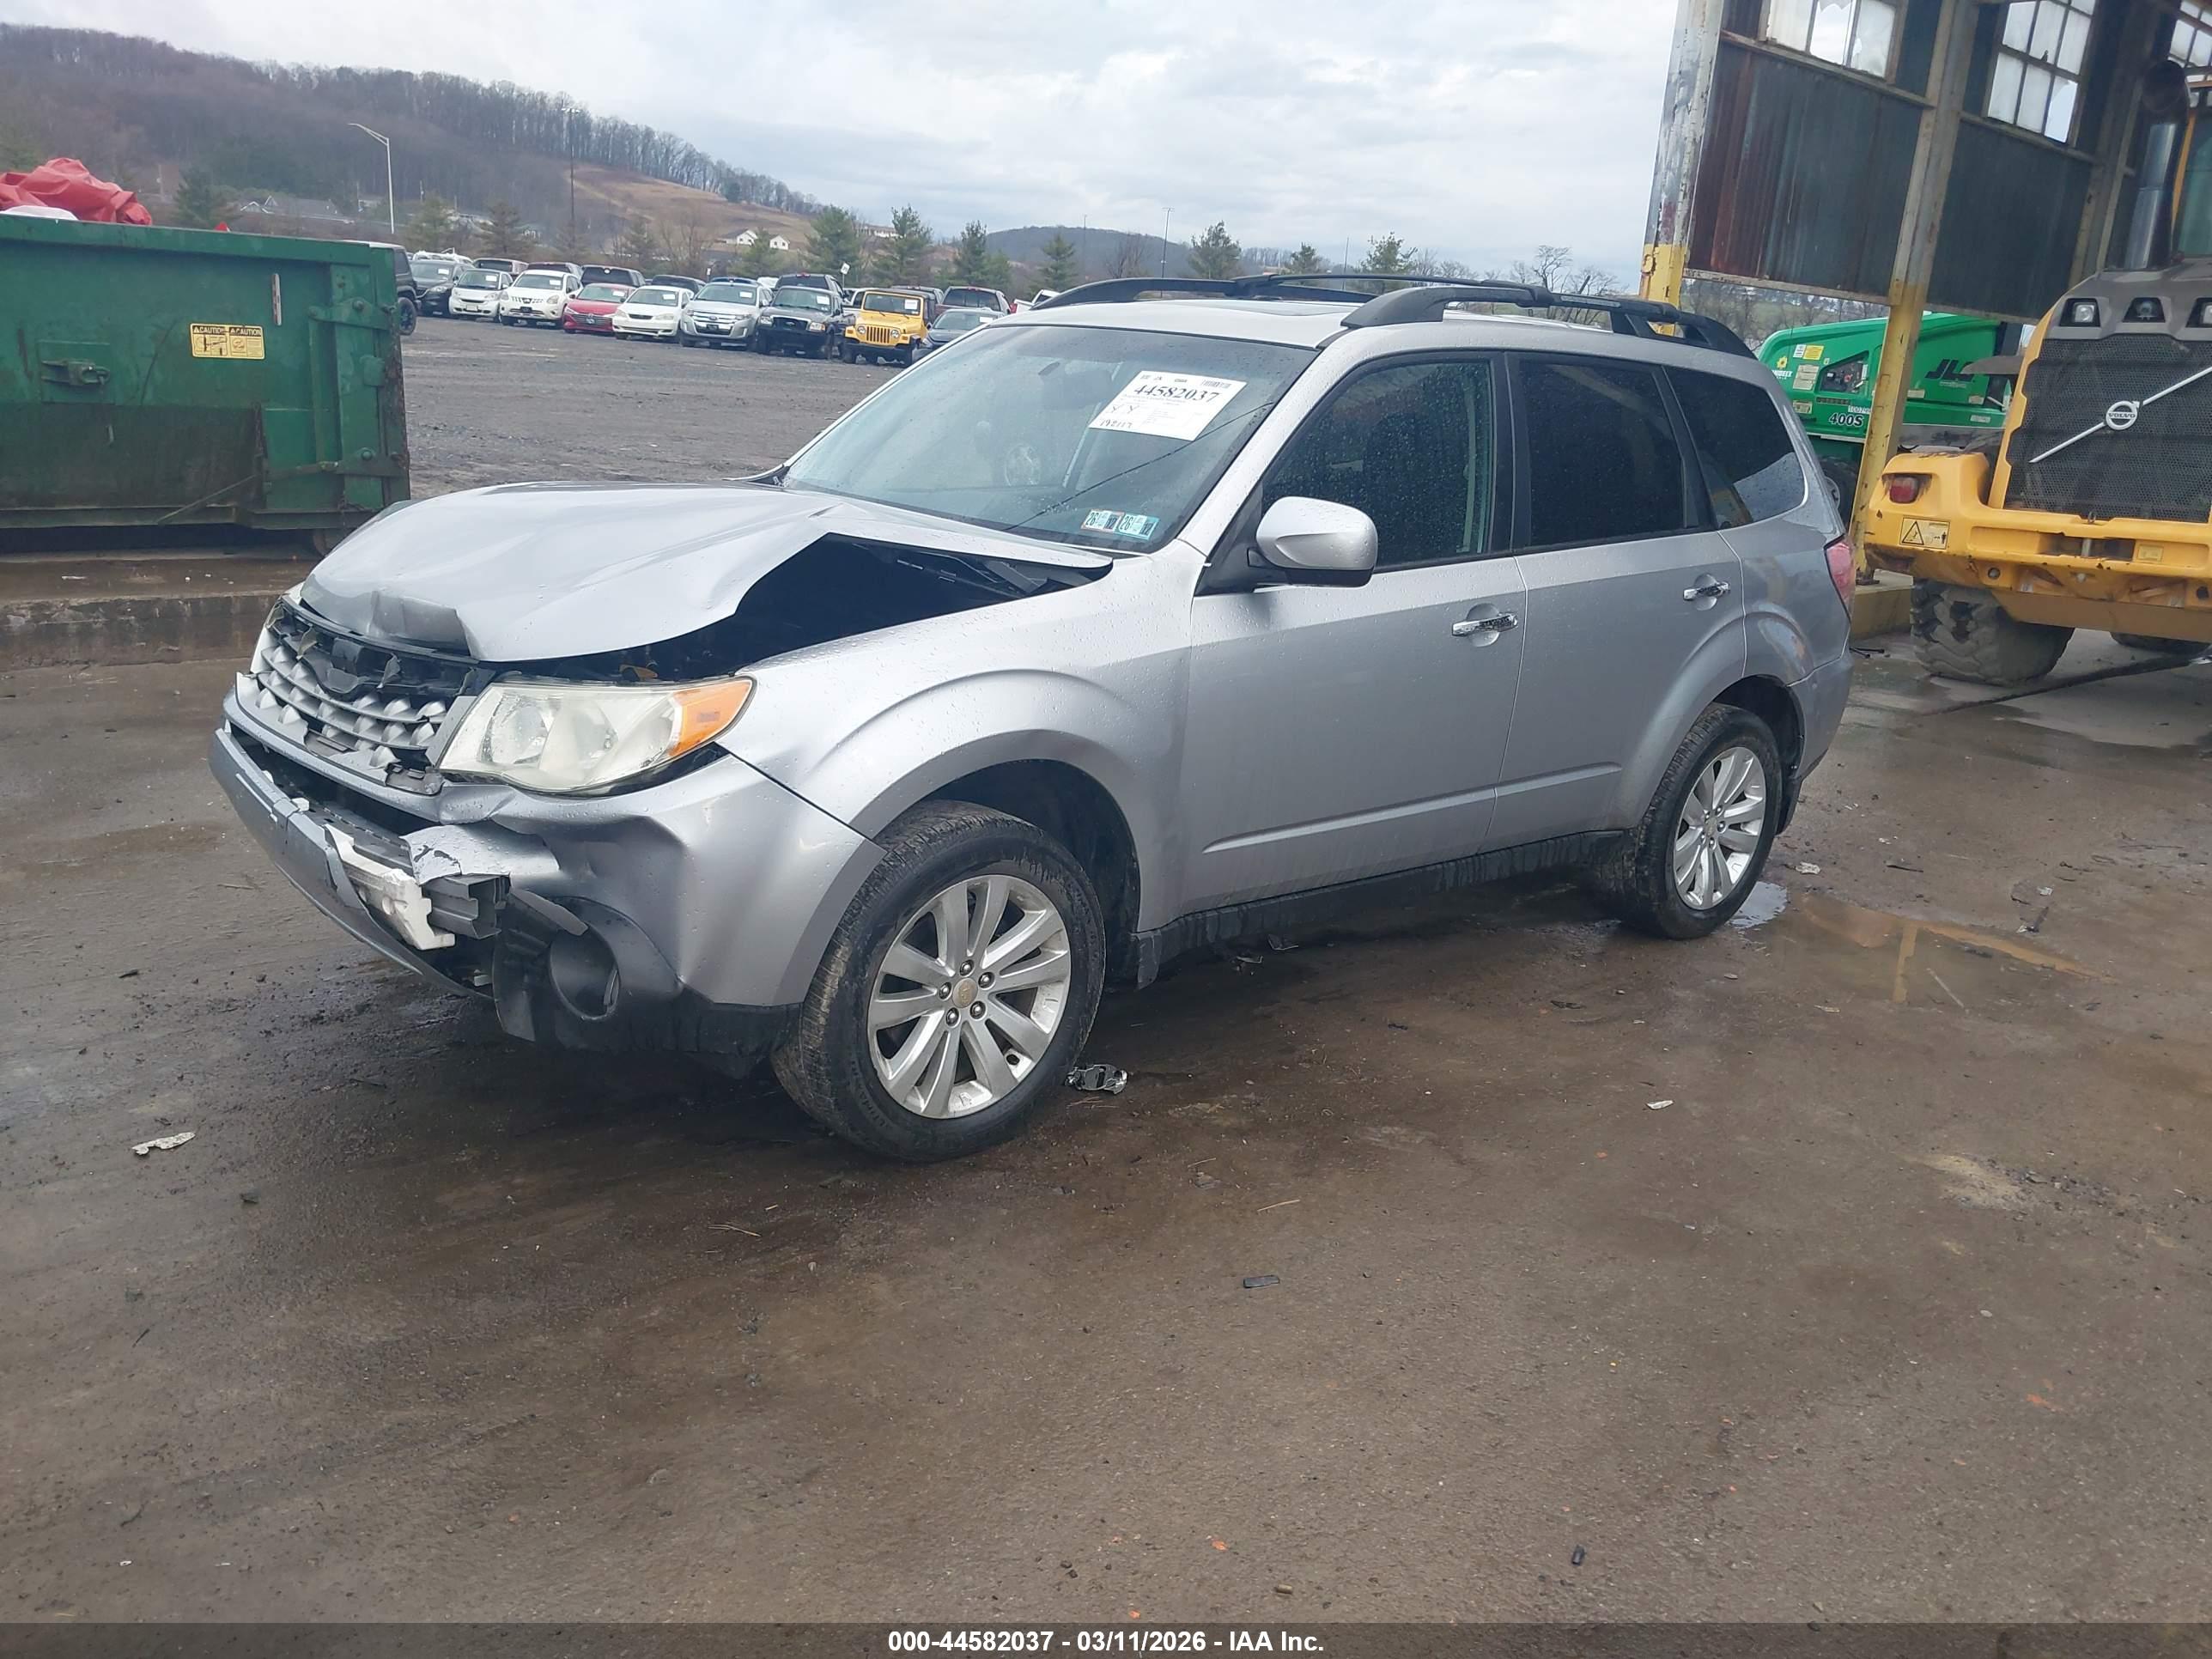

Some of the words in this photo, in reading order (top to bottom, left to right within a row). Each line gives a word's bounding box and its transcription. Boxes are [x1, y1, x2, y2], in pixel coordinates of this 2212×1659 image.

[1133, 384, 1222, 403] 44582037
[1828, 412, 1864, 427] 400S
[1085, 512, 1099, 526] 26
[1120, 515, 1133, 531] 26
